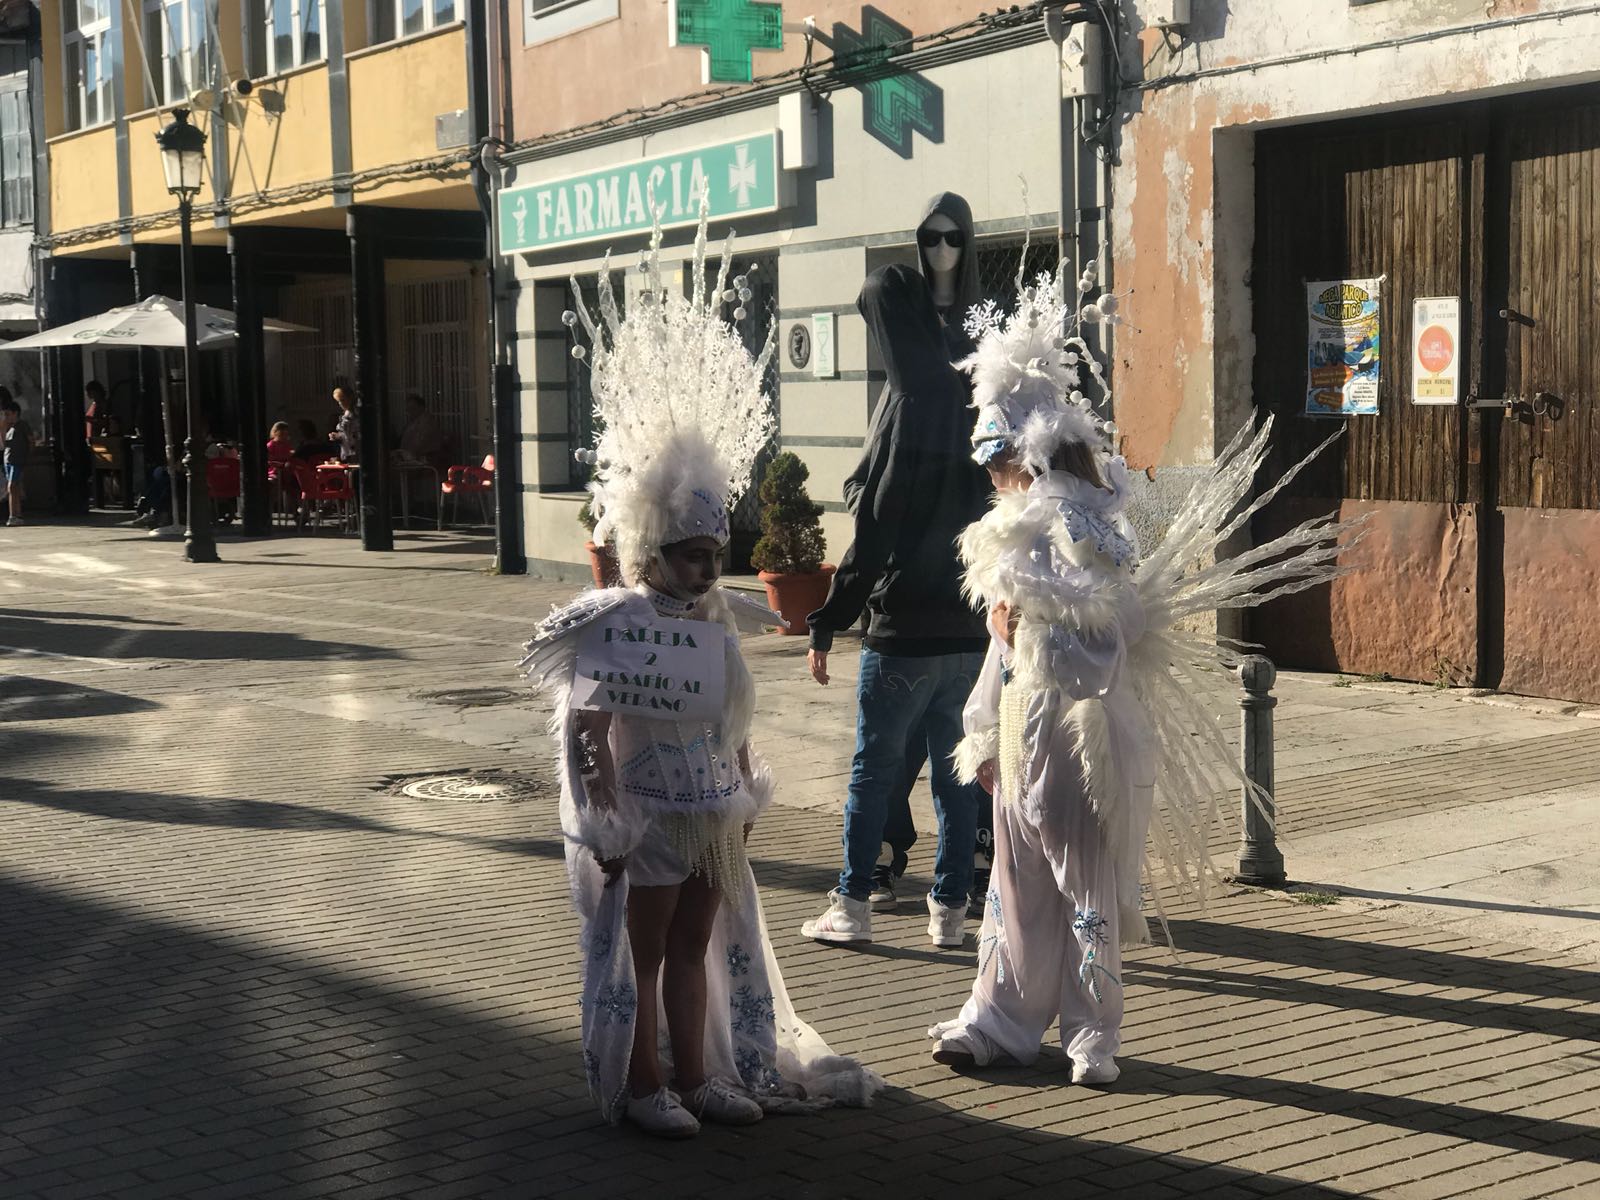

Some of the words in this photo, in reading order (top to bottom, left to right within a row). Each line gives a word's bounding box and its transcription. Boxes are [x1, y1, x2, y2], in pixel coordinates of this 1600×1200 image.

[537, 157, 708, 240] FARMACIA
[1340, 284, 1369, 302] PARQUE
[604, 627, 698, 648] PAREJA
[645, 651, 657, 667] 2
[593, 670, 675, 691] DESAFÍO
[679, 679, 704, 695] AL
[606, 689, 688, 713] VERANO
